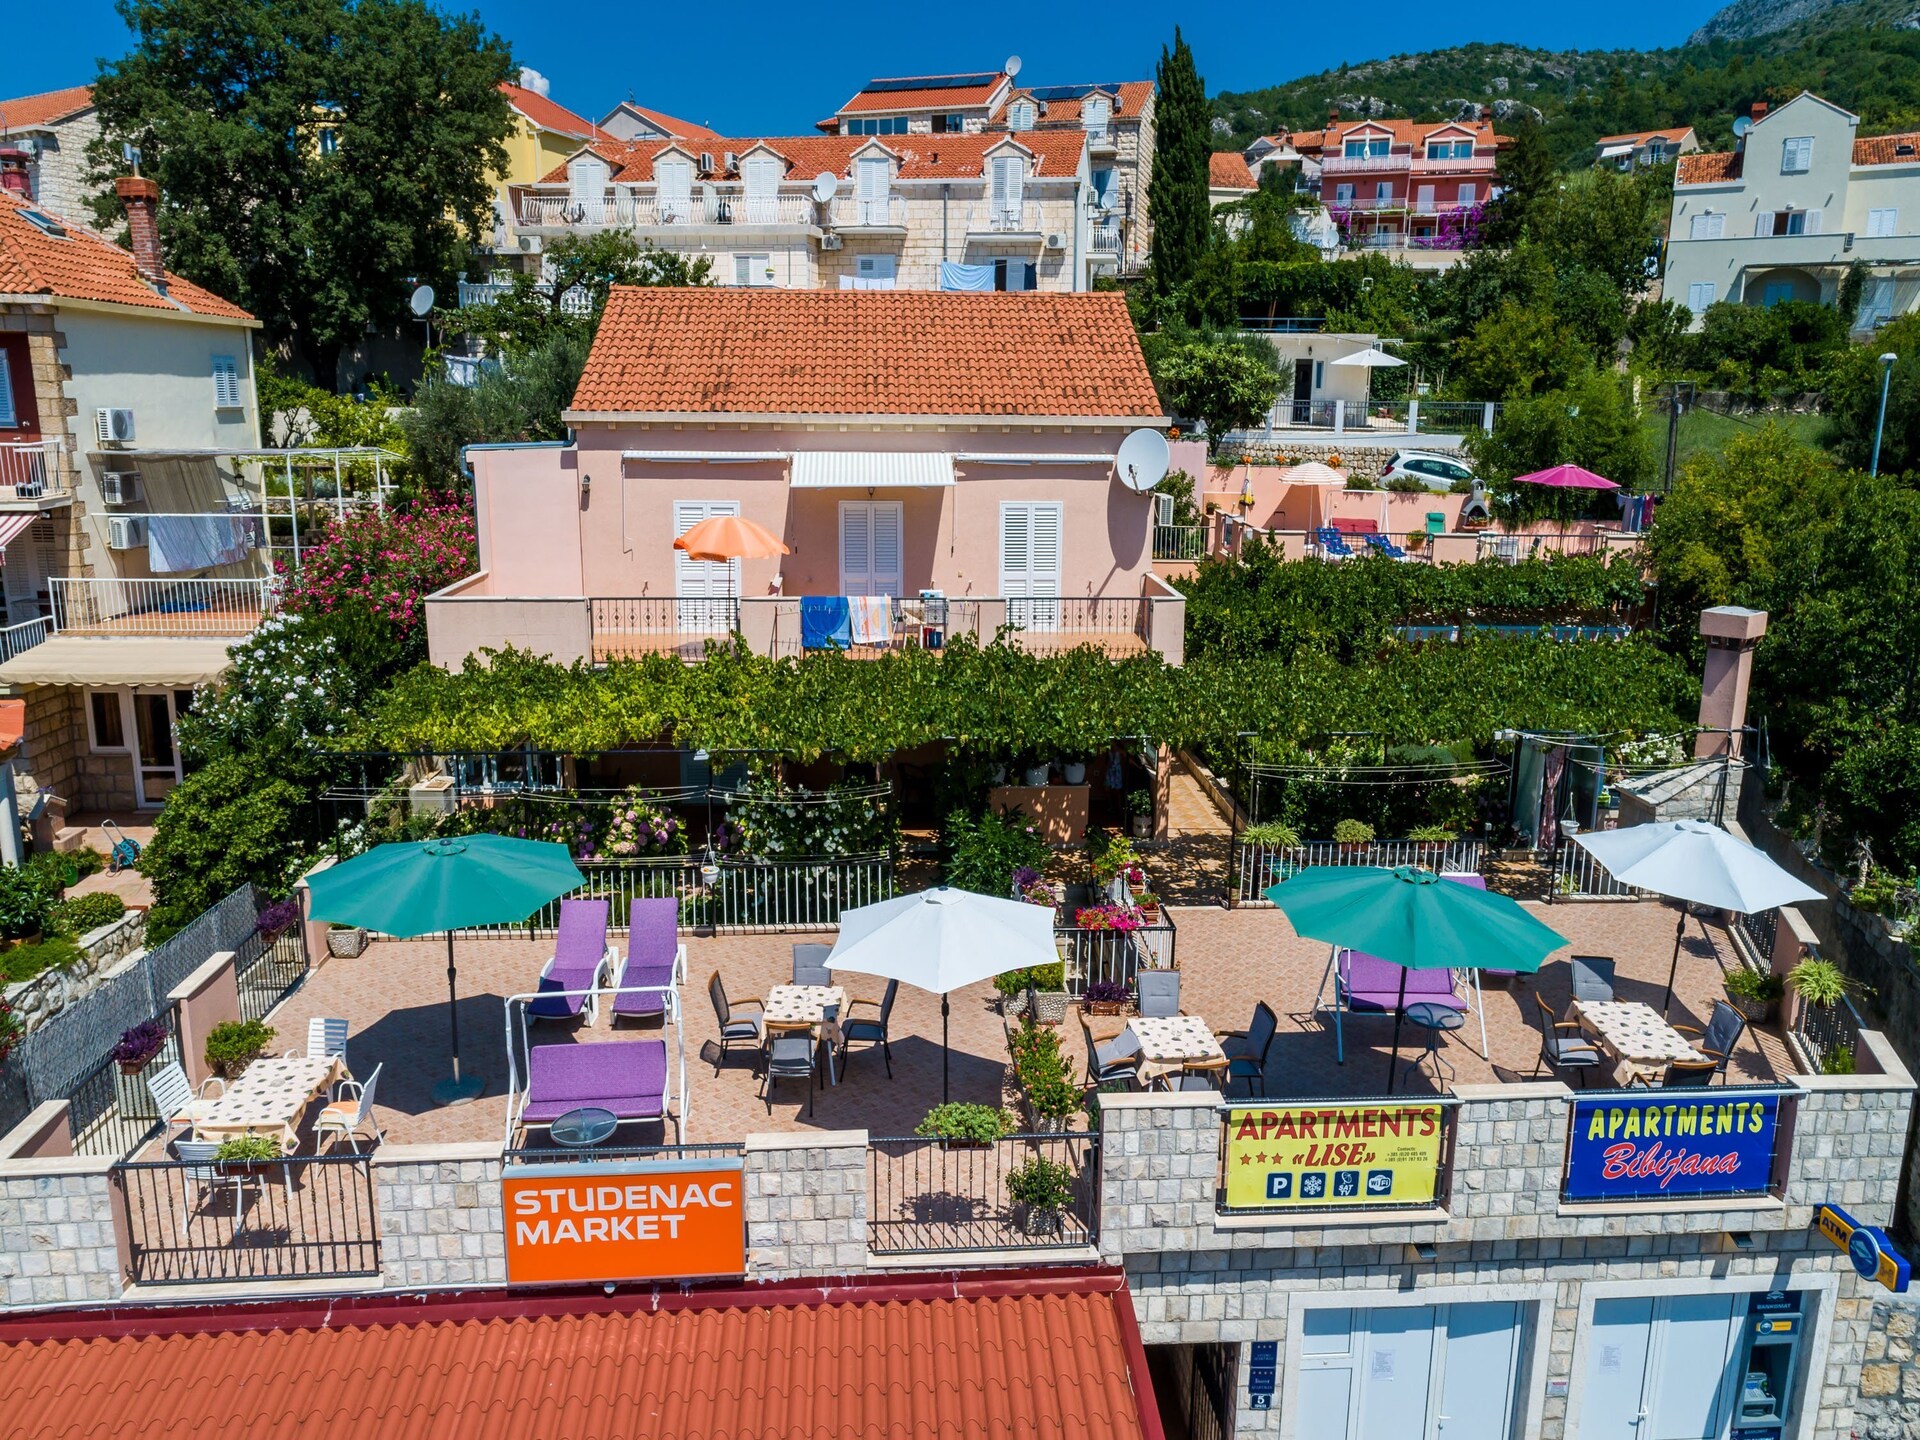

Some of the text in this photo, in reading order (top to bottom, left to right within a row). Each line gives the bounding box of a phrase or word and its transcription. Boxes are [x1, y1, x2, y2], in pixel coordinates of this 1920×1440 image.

[1235, 1108, 1436, 1141] APARTMENTS
[1587, 1102, 1765, 1141] APARTMENTS
[1602, 1141, 1742, 1188] Bibijana
[513, 1182, 732, 1215] STUDENAC
[1273, 1177, 1288, 1195] P
[515, 1214, 686, 1246] MARKET
[1822, 1216, 1847, 1243] ATM
[1257, 1395, 1265, 1404] 5
